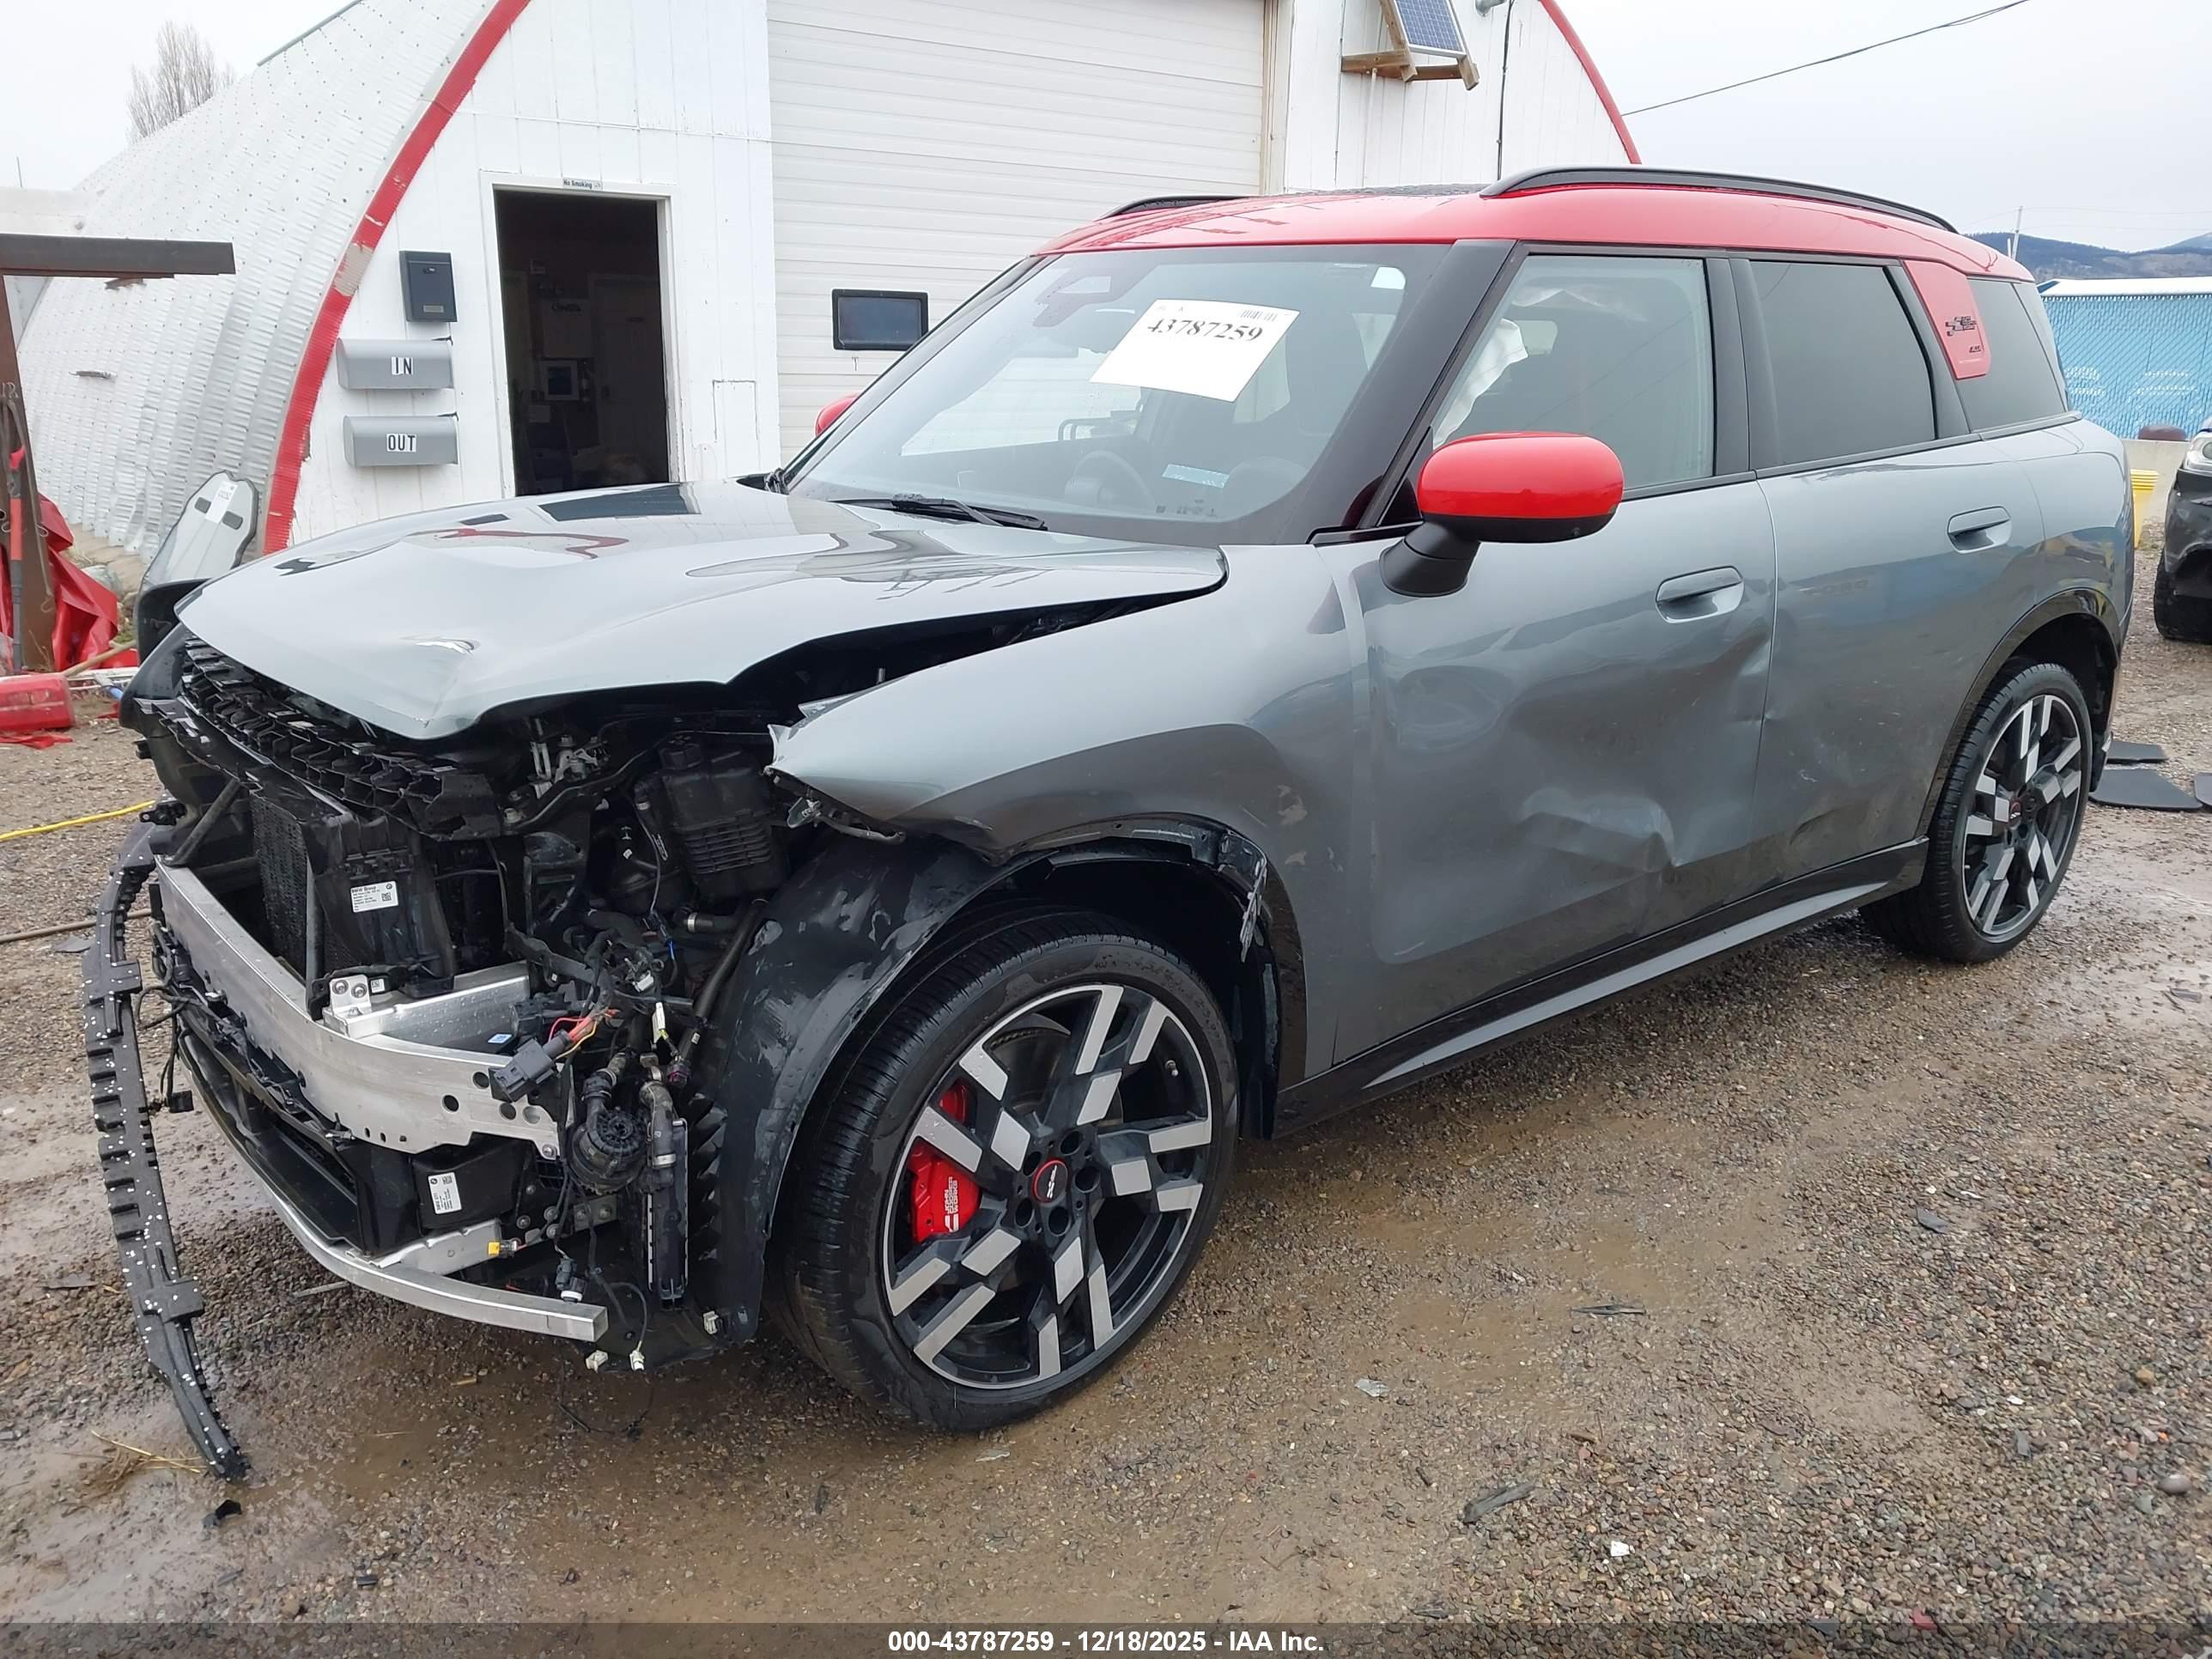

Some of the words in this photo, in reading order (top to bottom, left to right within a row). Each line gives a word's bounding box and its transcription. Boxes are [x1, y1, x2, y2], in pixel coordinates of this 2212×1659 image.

[1147, 318, 1264, 341] 43787259
[395, 356, 412, 374] IN
[388, 434, 416, 452] OUT
